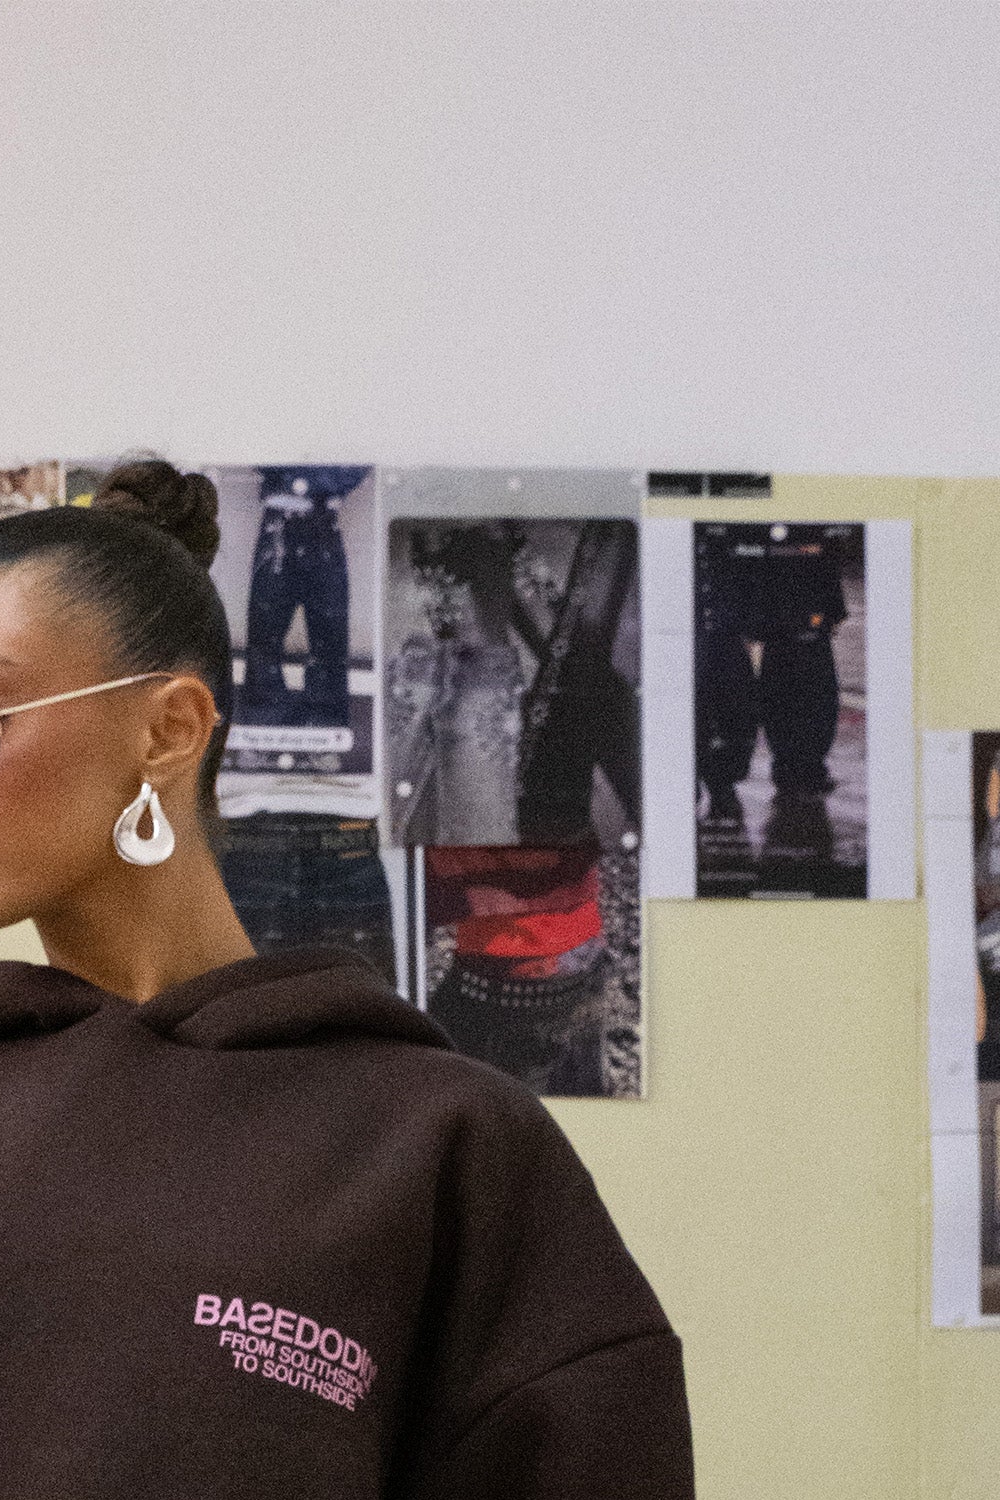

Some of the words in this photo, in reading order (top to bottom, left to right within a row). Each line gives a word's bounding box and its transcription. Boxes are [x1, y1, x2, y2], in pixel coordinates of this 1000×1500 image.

[219, 1330, 276, 1359] FROM
[232, 1350, 259, 1374] TO
[261, 1360, 356, 1412] SOUTHSIDE
